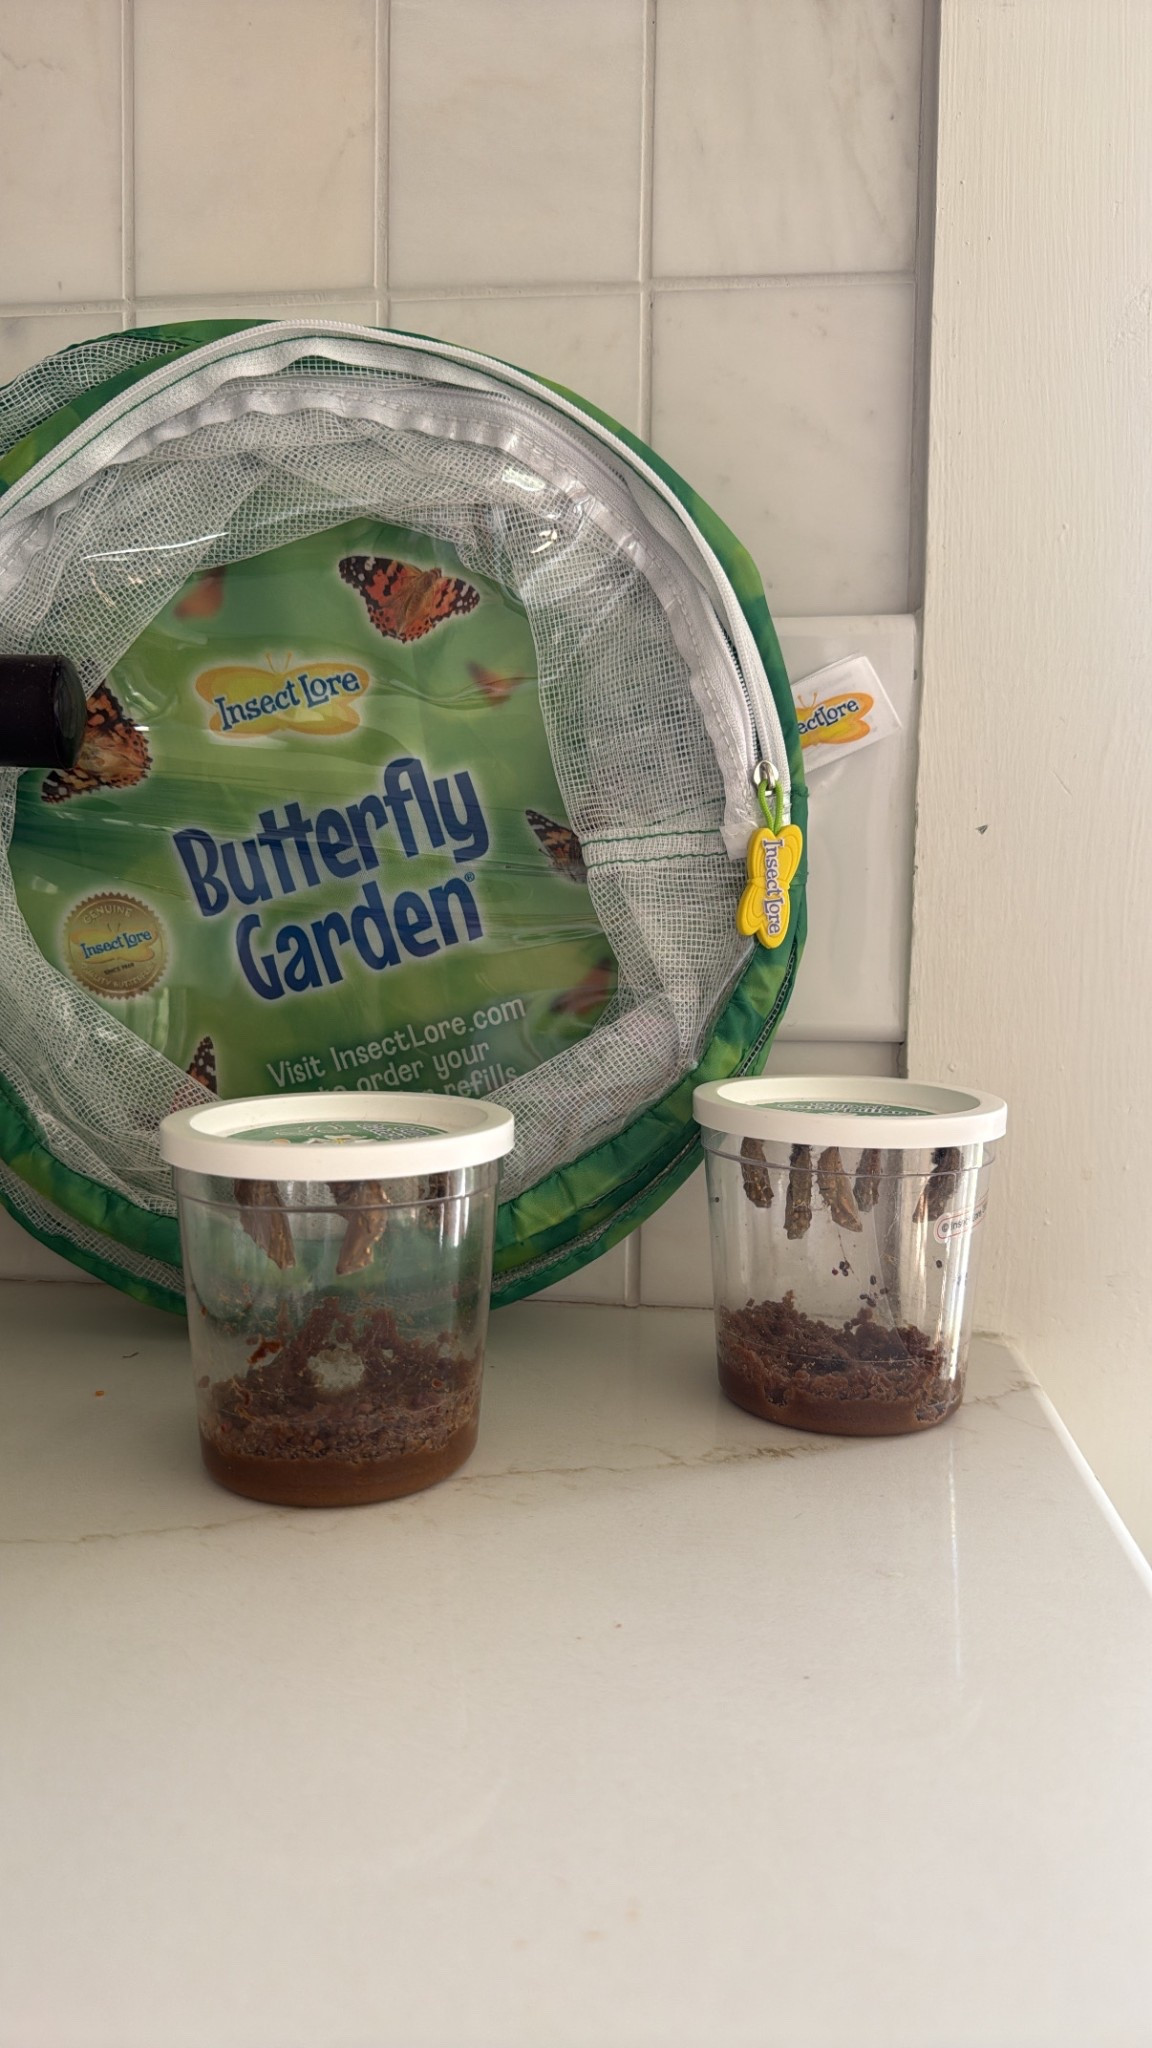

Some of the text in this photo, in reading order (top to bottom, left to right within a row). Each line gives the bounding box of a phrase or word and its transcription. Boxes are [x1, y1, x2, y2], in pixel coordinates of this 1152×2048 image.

[173, 758, 489, 916] Butterfly
[83, 904, 133, 924] GENUINE
[266, 998, 526, 1088] Visit InsectLore.com
[357, 1042, 490, 1091] order your
